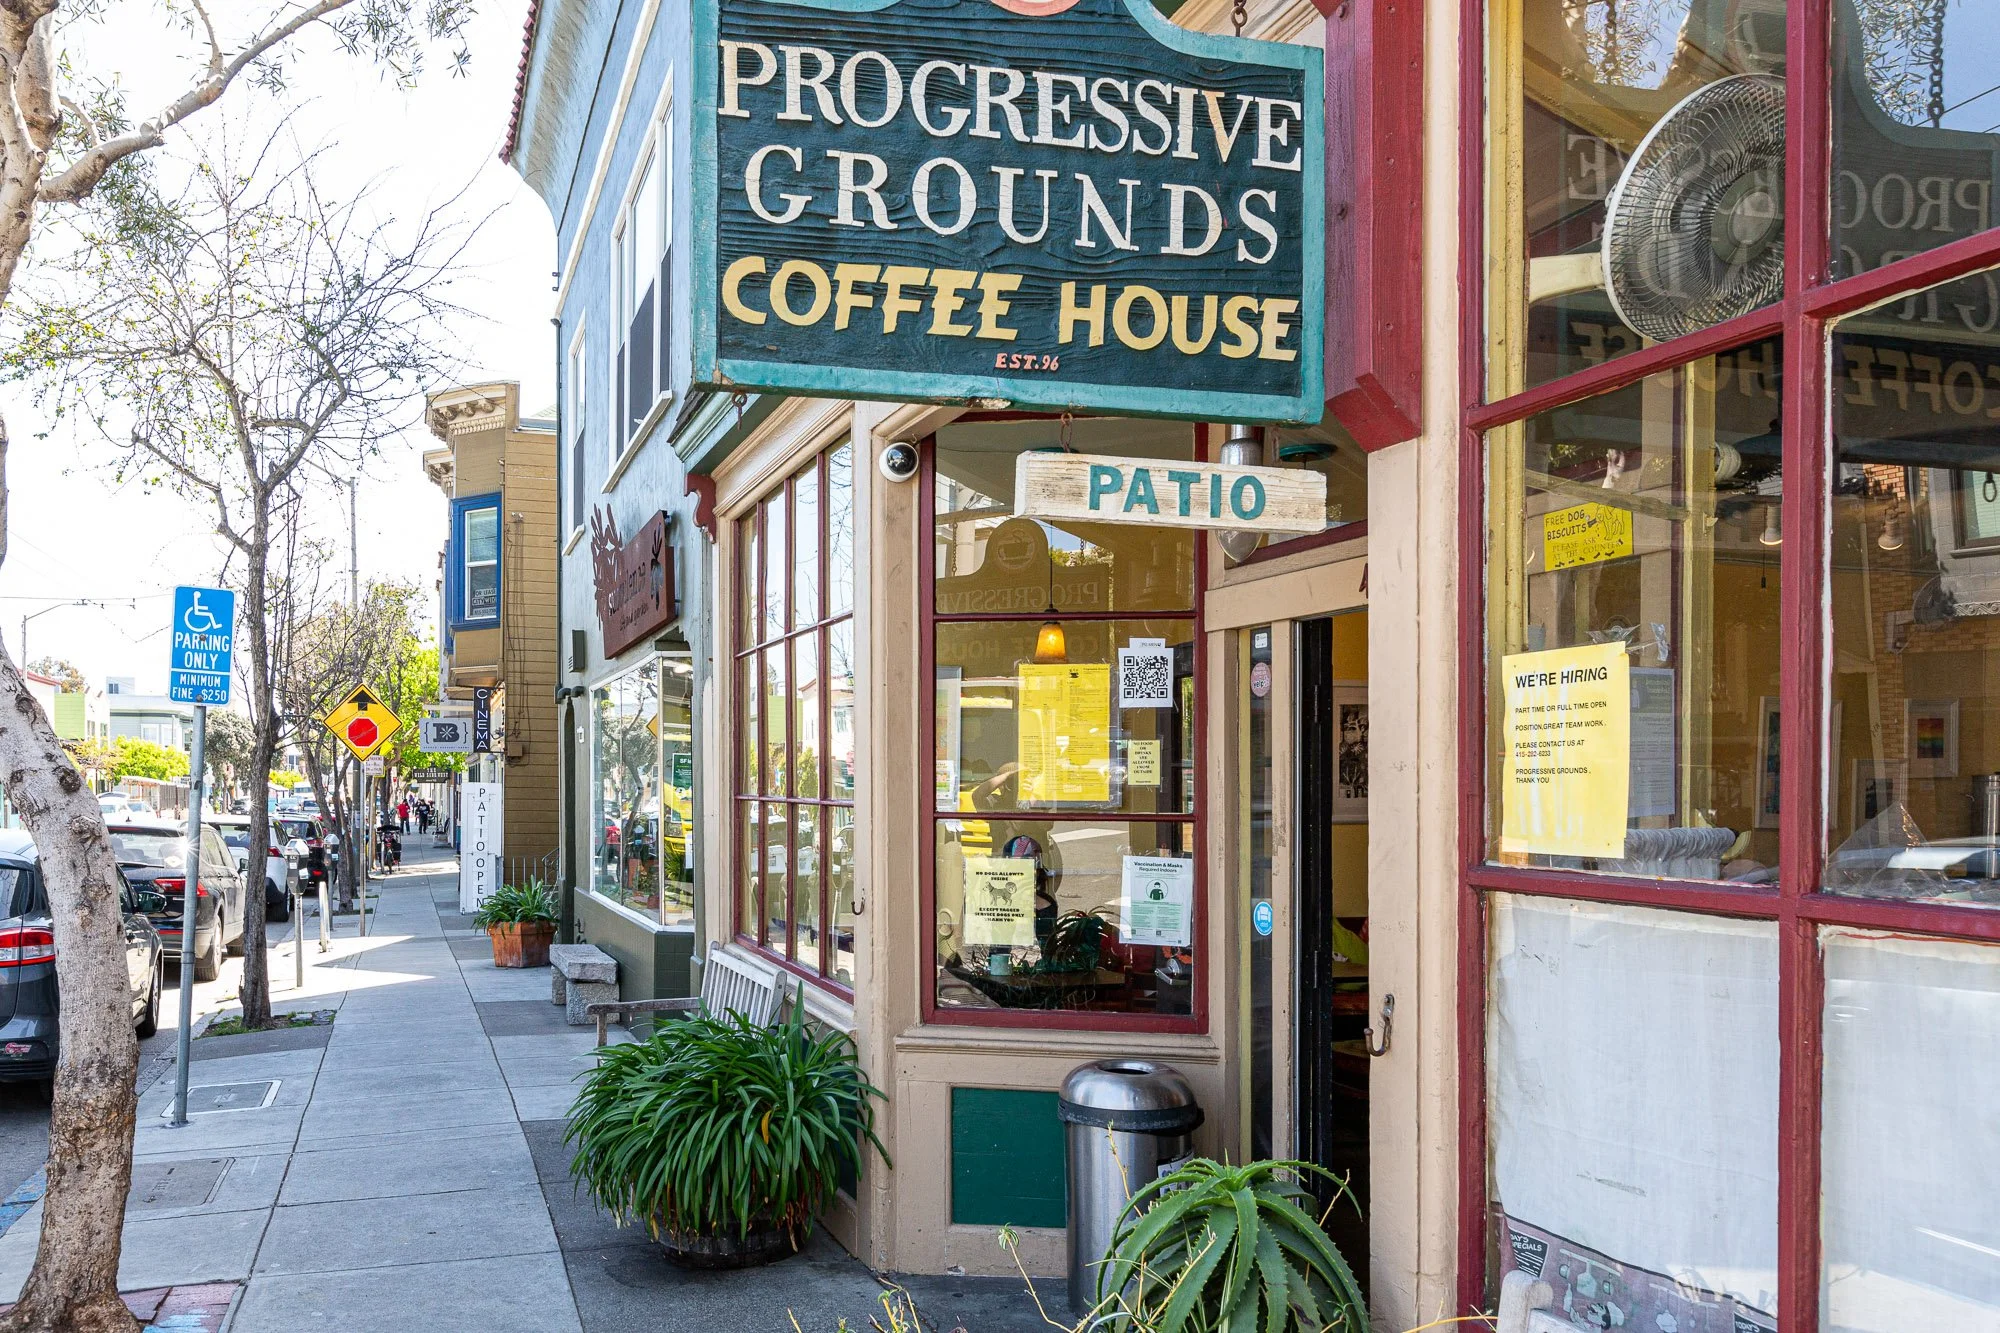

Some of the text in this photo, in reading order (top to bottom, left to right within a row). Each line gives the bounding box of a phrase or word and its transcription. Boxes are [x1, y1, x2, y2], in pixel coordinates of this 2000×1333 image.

[718, 40, 1302, 172] PROGRESSIVE
[744, 144, 1278, 264] GROUNDS
[722, 256, 1299, 362] COFFEE HOUSE
[1088, 464, 1266, 520] PATIO
[1545, 509, 1585, 527] FREE DOG
[1547, 524, 1586, 540] BISCUITS
[175, 632, 230, 652] PARKING
[184, 651, 218, 670] ONLY
[180, 673, 220, 687] MINIMUM
[1516, 667, 1608, 688] WE'RE HIRING
[172, 686, 226, 701] FINE $250
[476, 688, 488, 750] CINEMA
[476, 788, 486, 852] PATIO
